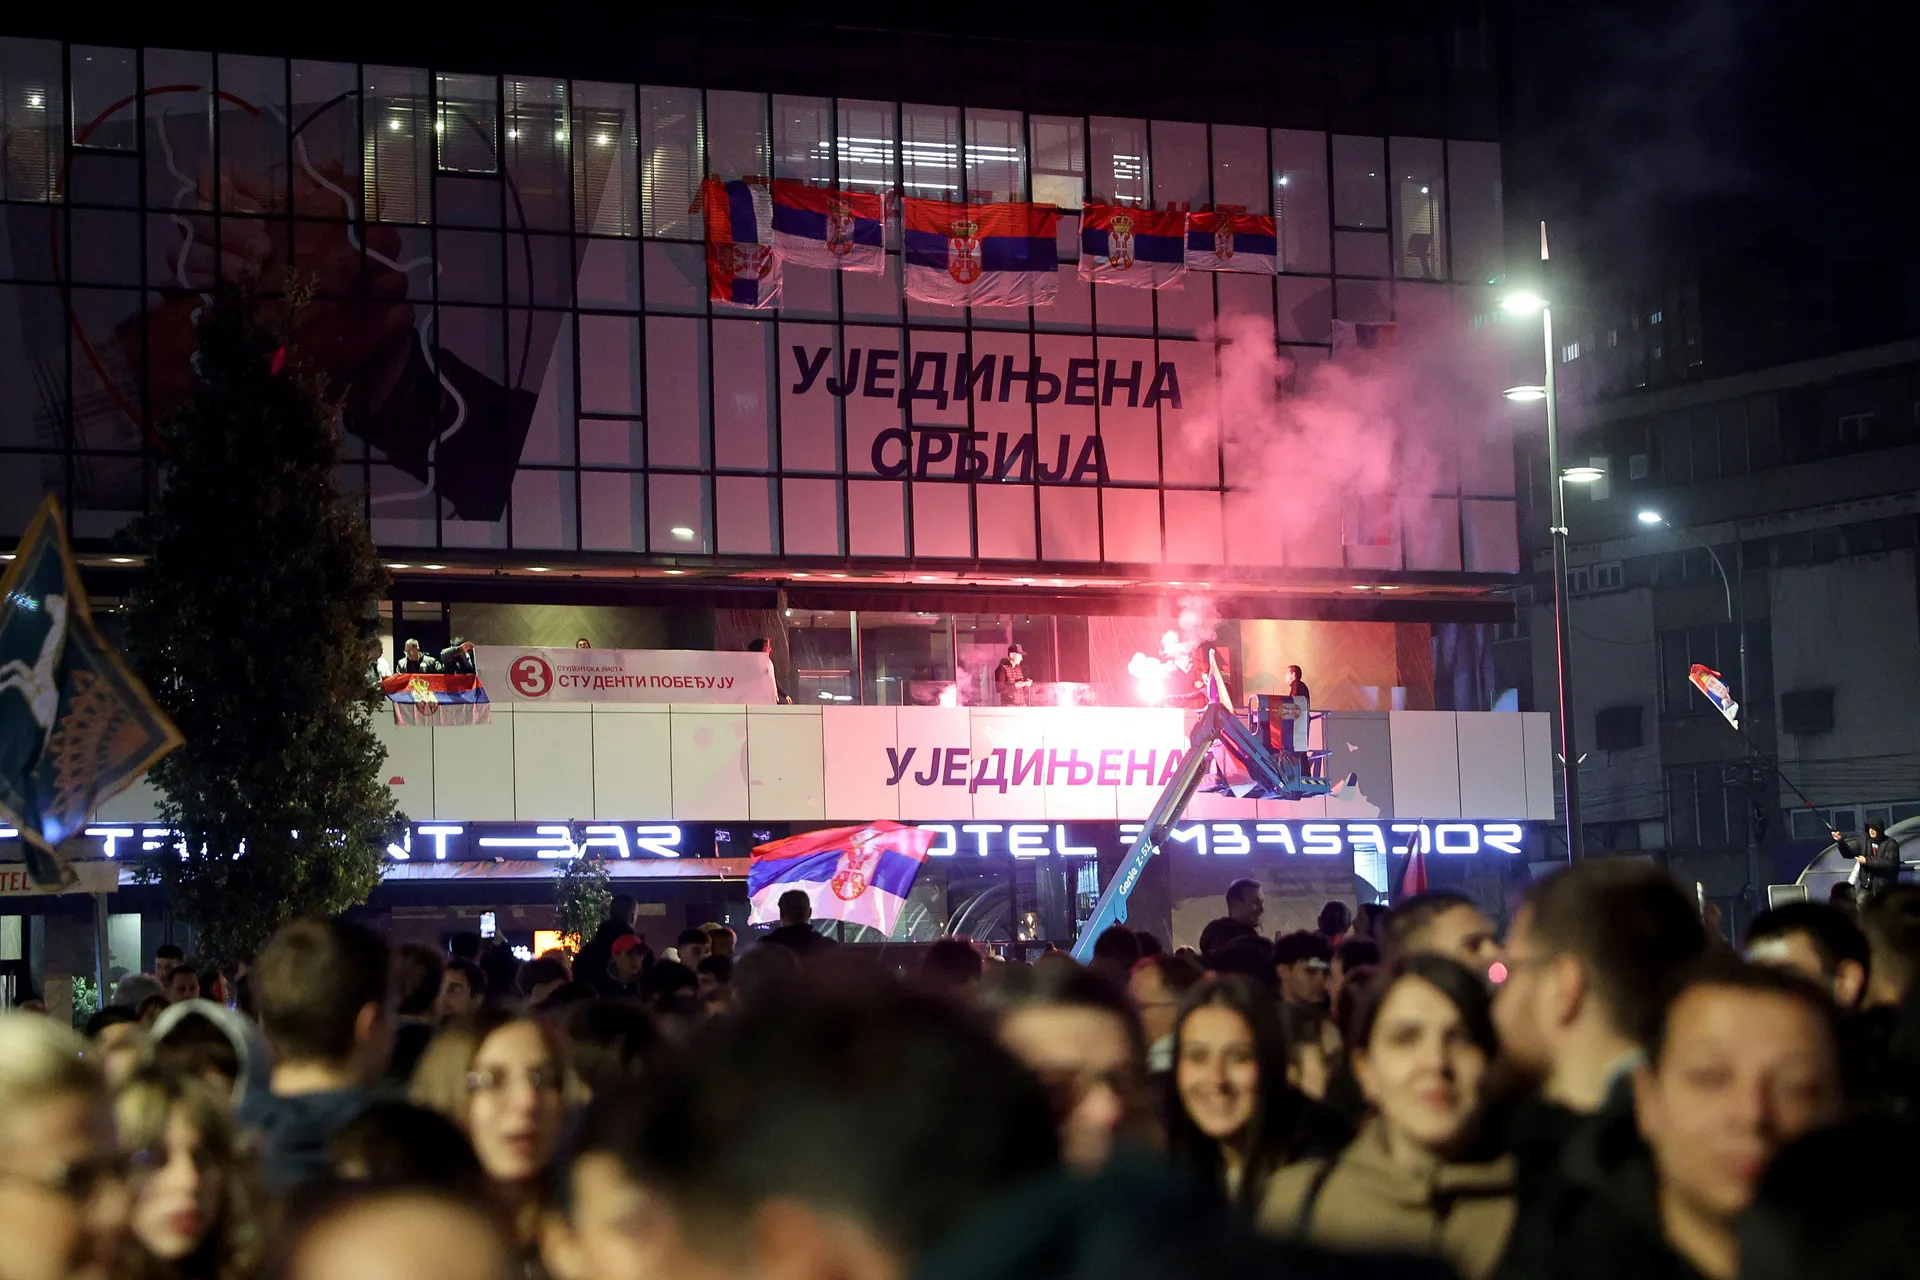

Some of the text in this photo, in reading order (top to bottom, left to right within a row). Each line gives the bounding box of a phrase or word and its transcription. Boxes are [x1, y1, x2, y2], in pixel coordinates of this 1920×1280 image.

[792, 345, 1182, 410] УЈЕДИЊЕНА
[871, 427, 1110, 483] СРБИЈА
[518, 659, 546, 689] 3
[558, 675, 735, 690] СТУДЕНТИ ПОБЕЂУЈУ
[886, 747, 1185, 793] УЈЕДИЊЕНА
[916, 824, 1098, 857] OTEL
[1119, 867, 1138, 895] Genie
